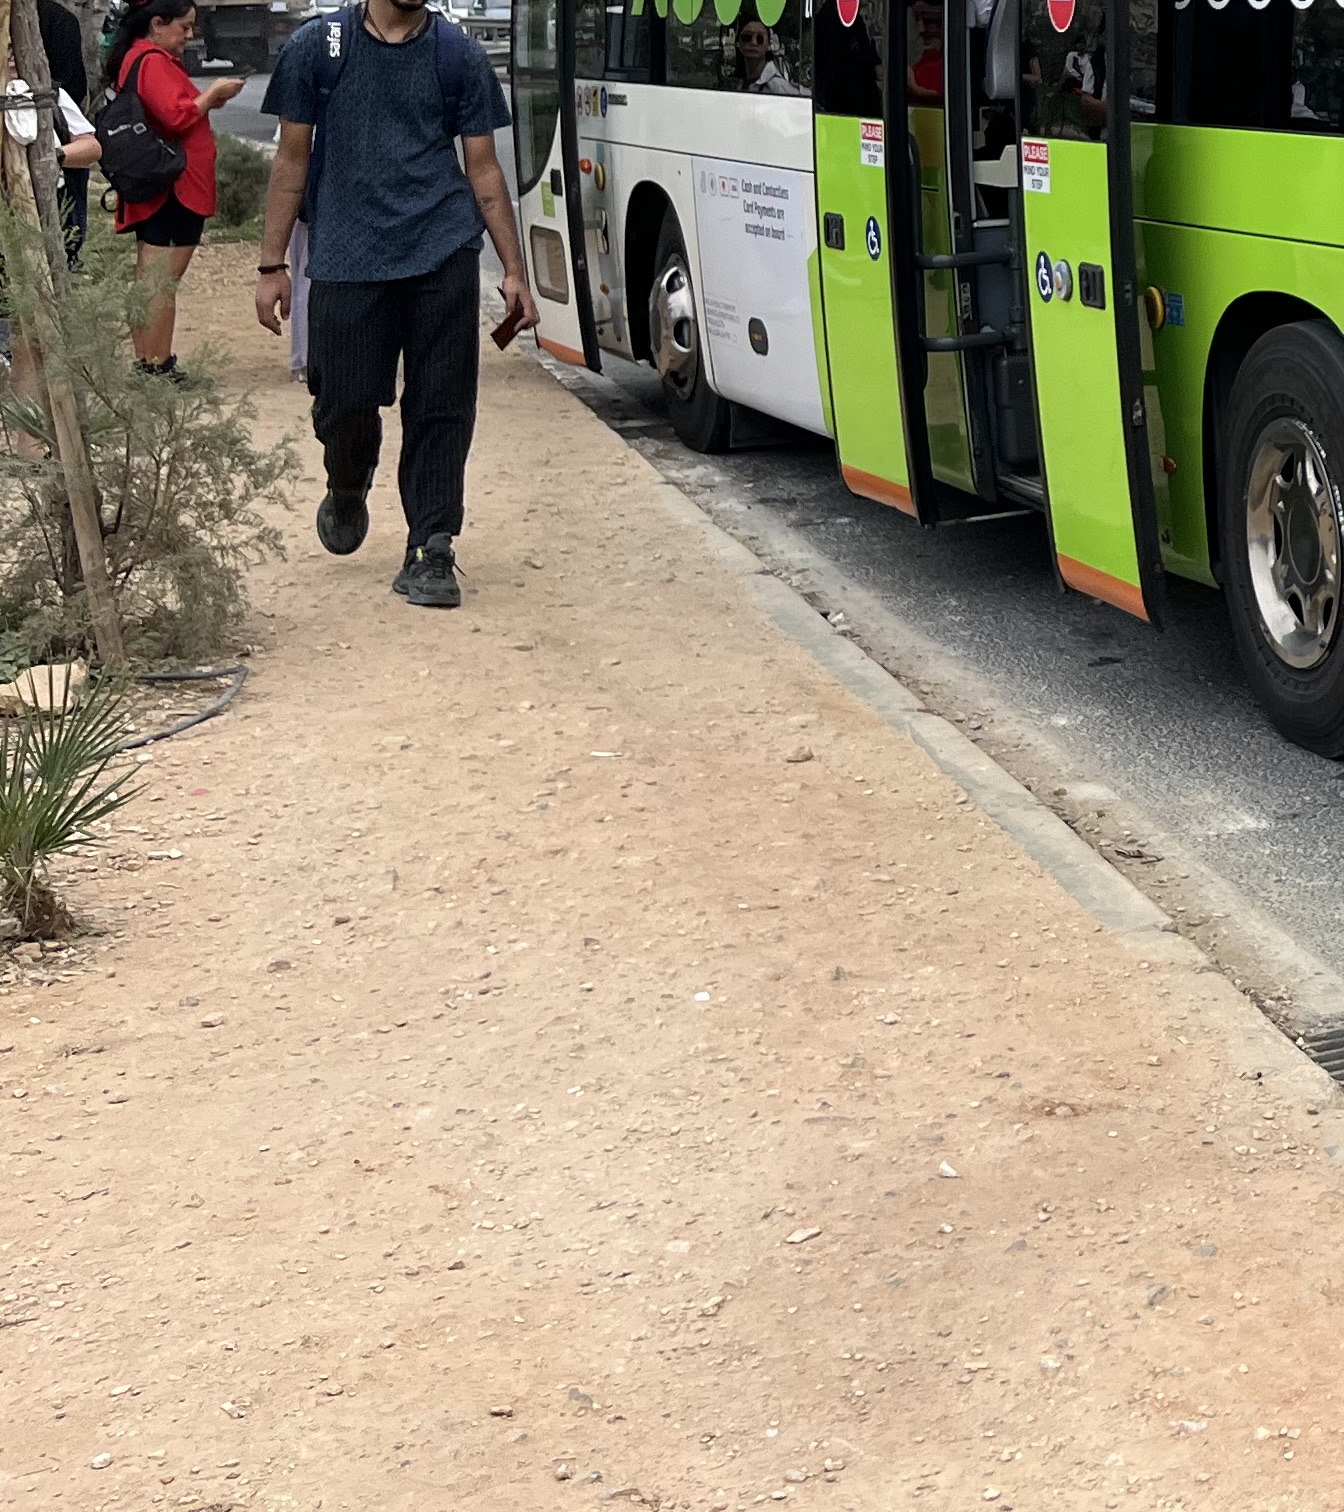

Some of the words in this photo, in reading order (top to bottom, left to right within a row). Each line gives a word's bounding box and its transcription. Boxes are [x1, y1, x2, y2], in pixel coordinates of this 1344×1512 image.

[327, 21, 342, 58] safari
[861, 124, 882, 139] PLEASE
[1023, 144, 1048, 160] PLEASE
